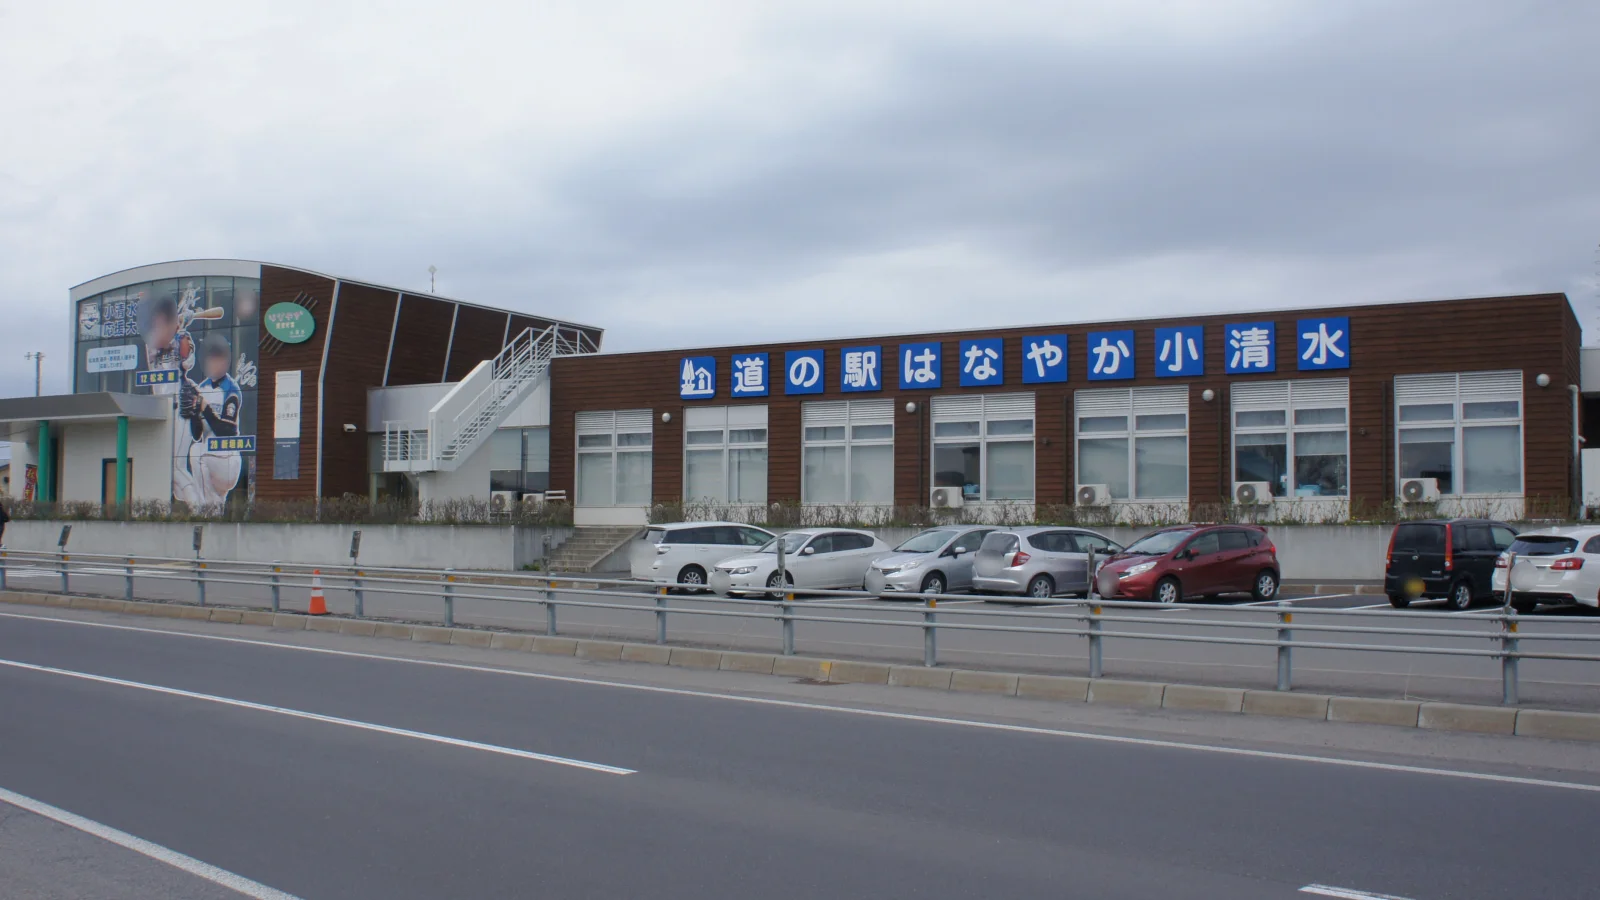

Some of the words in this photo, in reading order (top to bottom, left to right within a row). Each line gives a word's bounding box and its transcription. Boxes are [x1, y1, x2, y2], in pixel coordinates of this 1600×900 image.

[104, 302, 140, 320] 小清水
[103, 319, 140, 338] 応援大
[734, 323, 1345, 393] 道の駅はなやか小清水
